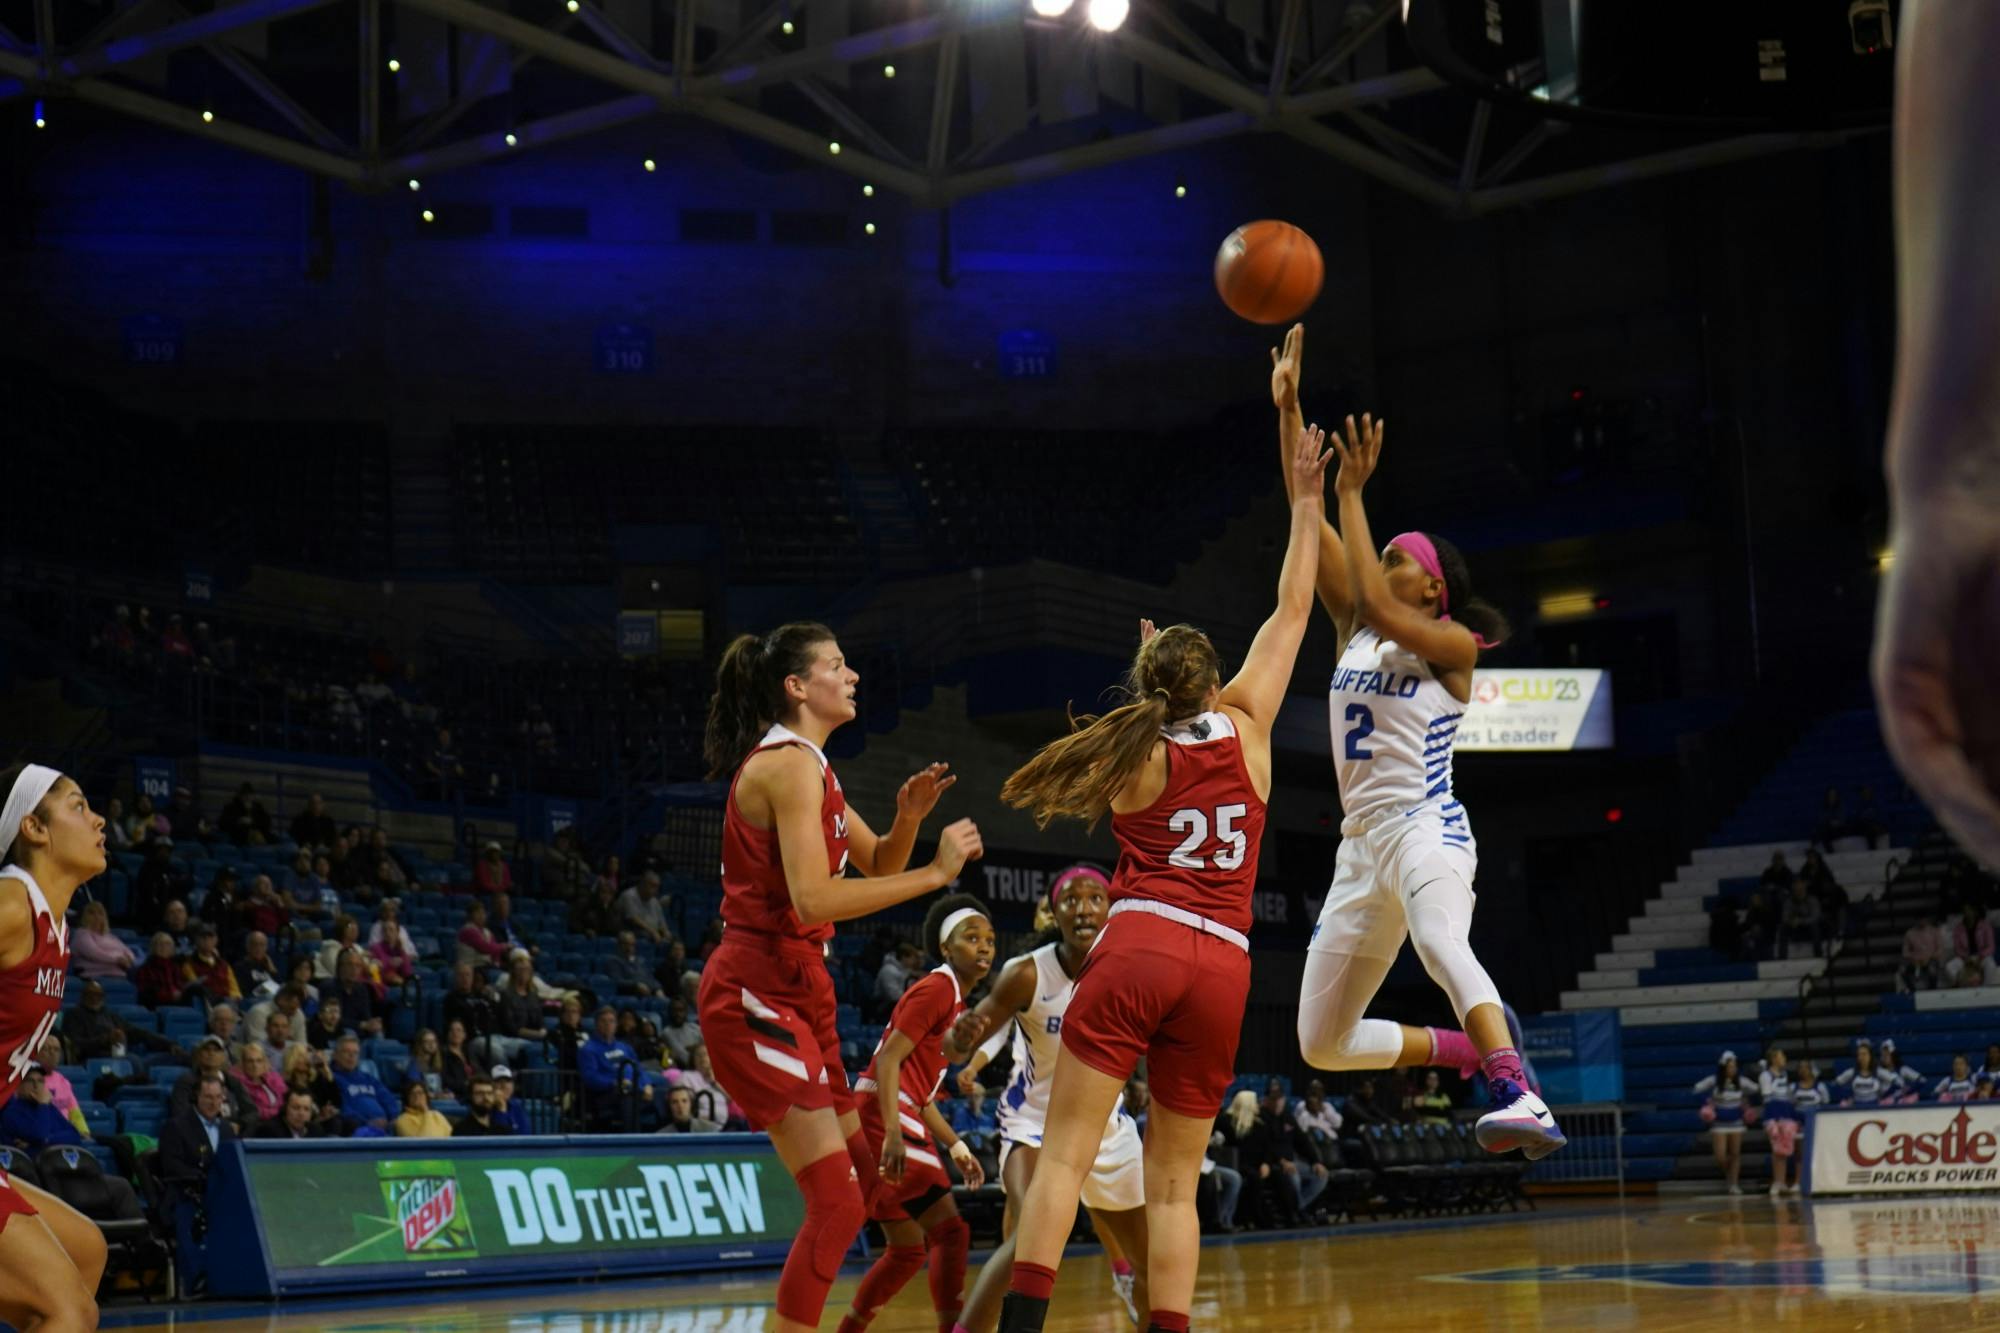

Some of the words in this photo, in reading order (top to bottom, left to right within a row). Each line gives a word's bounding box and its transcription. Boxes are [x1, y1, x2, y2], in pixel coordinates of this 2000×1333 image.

[605, 350, 643, 371] 310
[1013, 355, 1046, 375] 311
[1331, 667, 1421, 698] UFFALO
[1345, 703, 1375, 760] 2
[1488, 727, 1559, 743] Leader
[143, 778, 169, 797] 104
[1168, 803, 1247, 870] 25
[982, 865, 1044, 903] TRUE
[1847, 1104, 1997, 1167] Castle
[1872, 1170, 1929, 1184] PACKS
[1934, 1168, 1997, 1182] POWER
